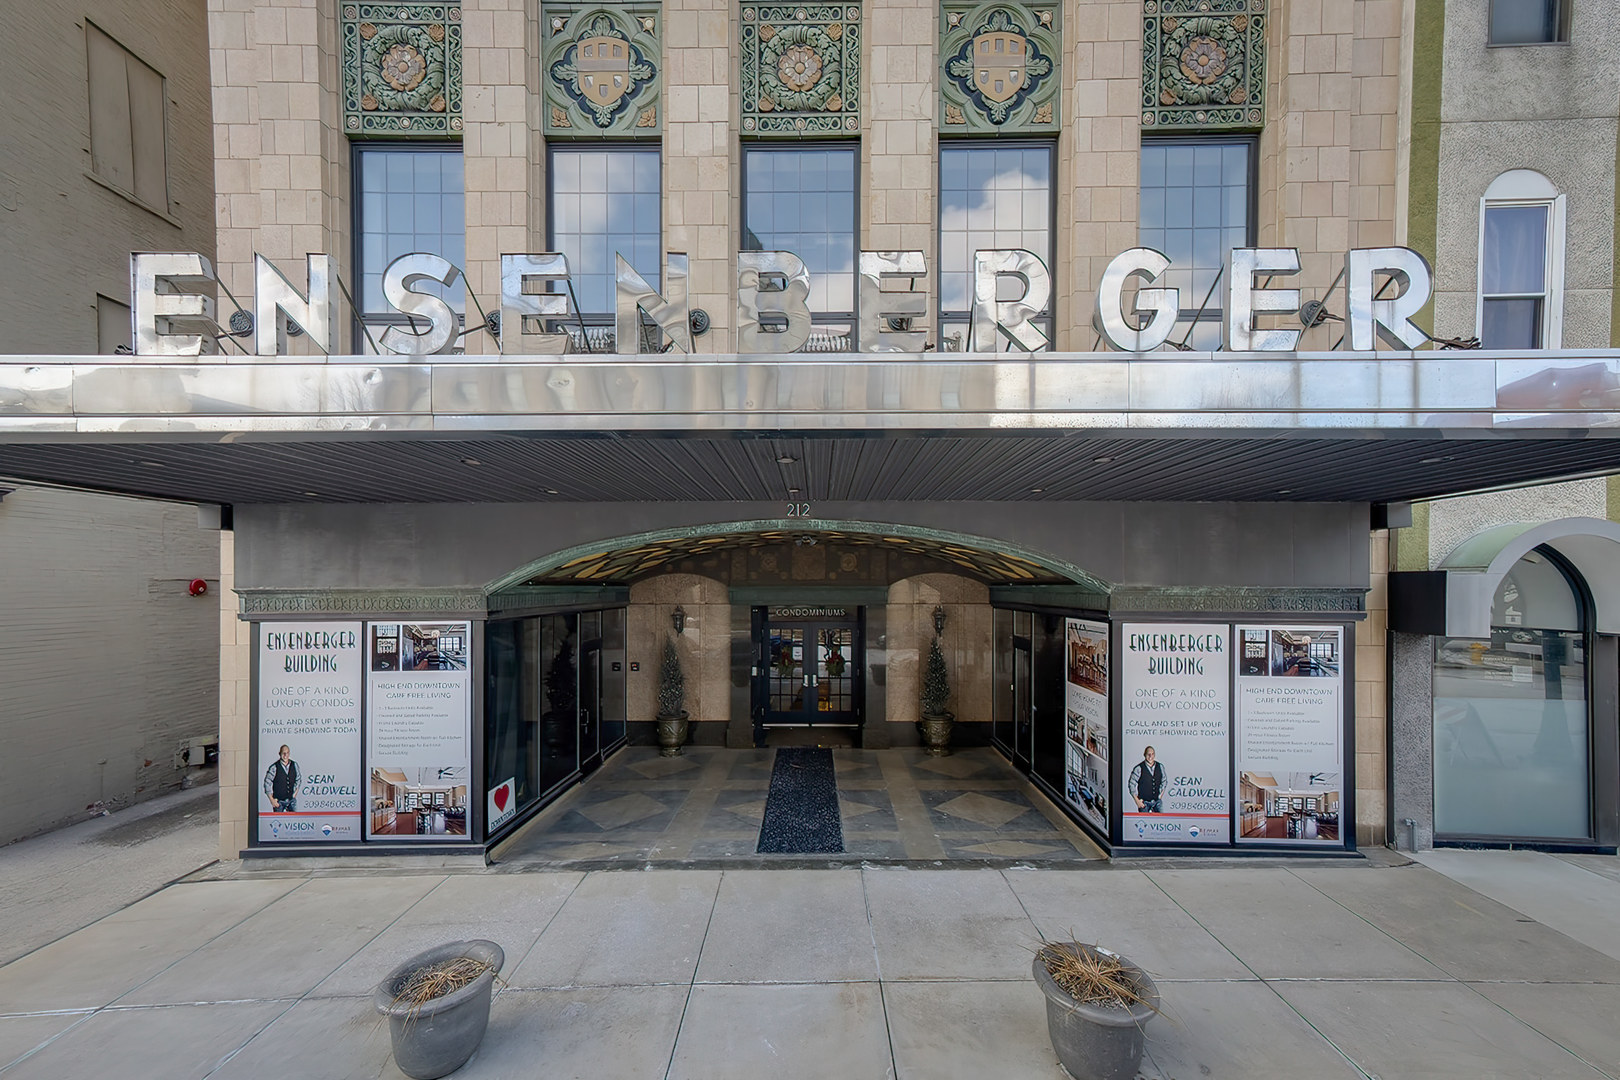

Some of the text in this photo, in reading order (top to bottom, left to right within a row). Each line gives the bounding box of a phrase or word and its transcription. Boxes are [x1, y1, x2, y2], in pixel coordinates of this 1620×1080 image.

[131, 247, 1433, 356] ENSENBERGER
[787, 503, 811, 517] 212
[776, 608, 846, 617] CONDOMINIUMS
[266, 630, 356, 650] ENSENBERGER
[1129, 633, 1223, 653] ENSENBERGER
[283, 653, 337, 673] BUILDING
[1147, 656, 1204, 676] BUILDING
[271, 685, 349, 696] ONE OF A KIND
[377, 682, 461, 690] HIGH END DOWNTOWN
[1135, 688, 1217, 698] ONE OF A KIND
[1284, 688, 1333, 696] DOWNTOWN
[266, 698, 355, 709] LUXURY CONDOS
[1129, 700, 1223, 711] LUXURY CONDOS
[265, 717, 355, 726] CALL AND SET UP YOUR
[1187, 720, 1199, 728] UP
[261, 726, 358, 734] PRIVATE SHOWING TODAY
[1200, 729, 1227, 737] TODAY
[307, 774, 335, 784] SEAN
[1173, 776, 1203, 786] SEAN
[302, 785, 358, 796] CALDWELL
[1167, 787, 1226, 798] CALDWELL
[284, 822, 315, 831] VISION
[1149, 823, 1182, 832] VISION
